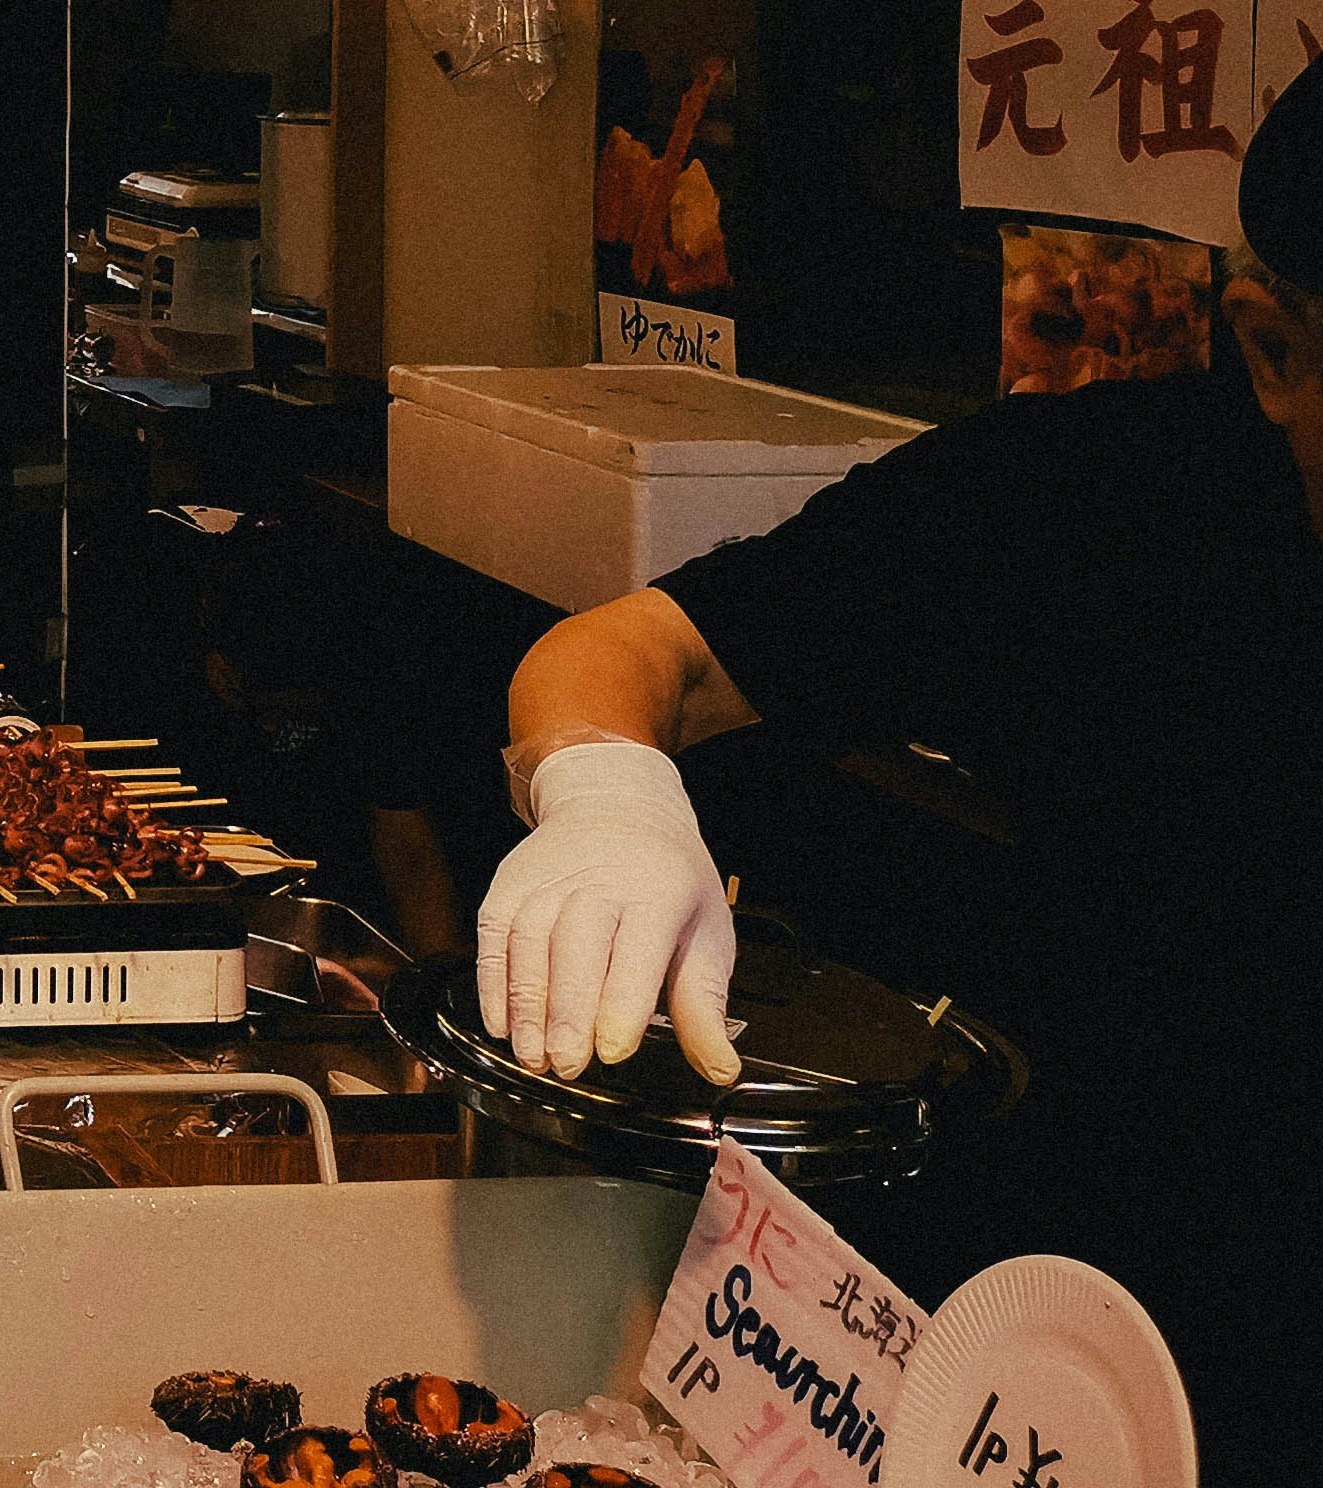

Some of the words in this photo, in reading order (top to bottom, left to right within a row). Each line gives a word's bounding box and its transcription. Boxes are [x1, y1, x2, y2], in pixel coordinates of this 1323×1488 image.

[620, 300, 722, 371] ゆでかに
[705, 1157, 798, 1290] うに
